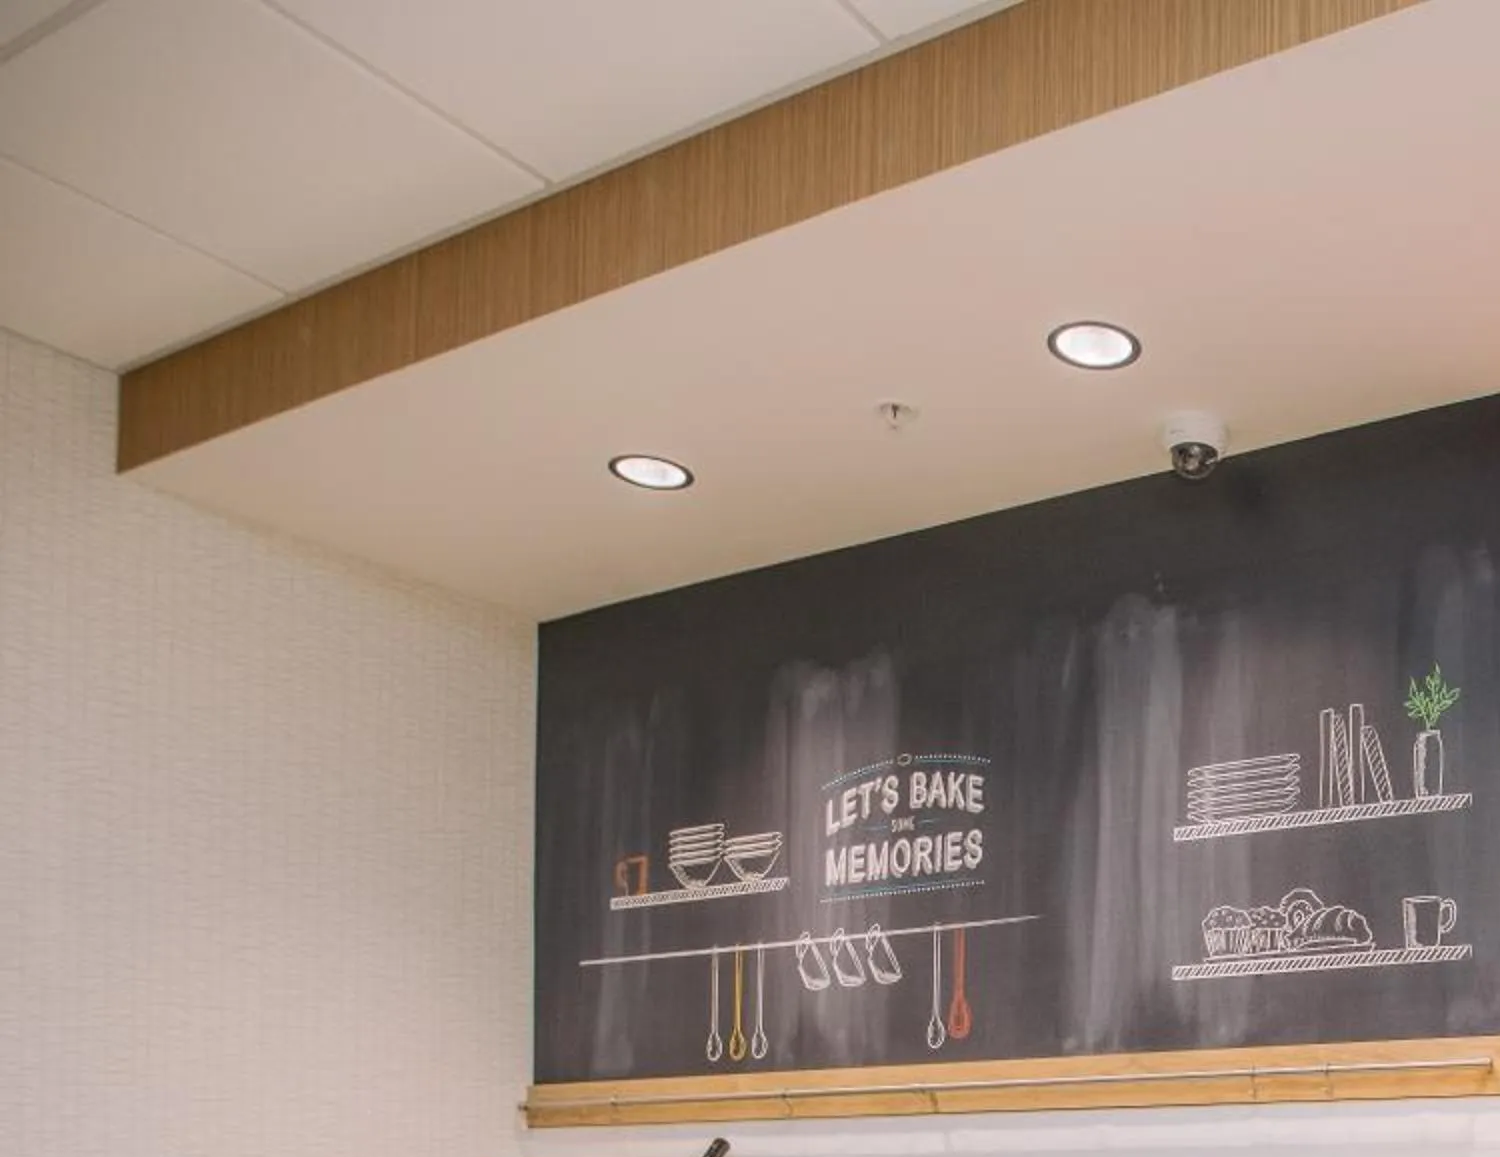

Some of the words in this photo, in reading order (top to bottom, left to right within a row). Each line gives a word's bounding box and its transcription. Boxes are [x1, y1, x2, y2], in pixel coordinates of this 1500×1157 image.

[825, 775, 899, 838] LET'S
[909, 771, 985, 813] BAKE
[825, 829, 983, 887] MEMORIES
